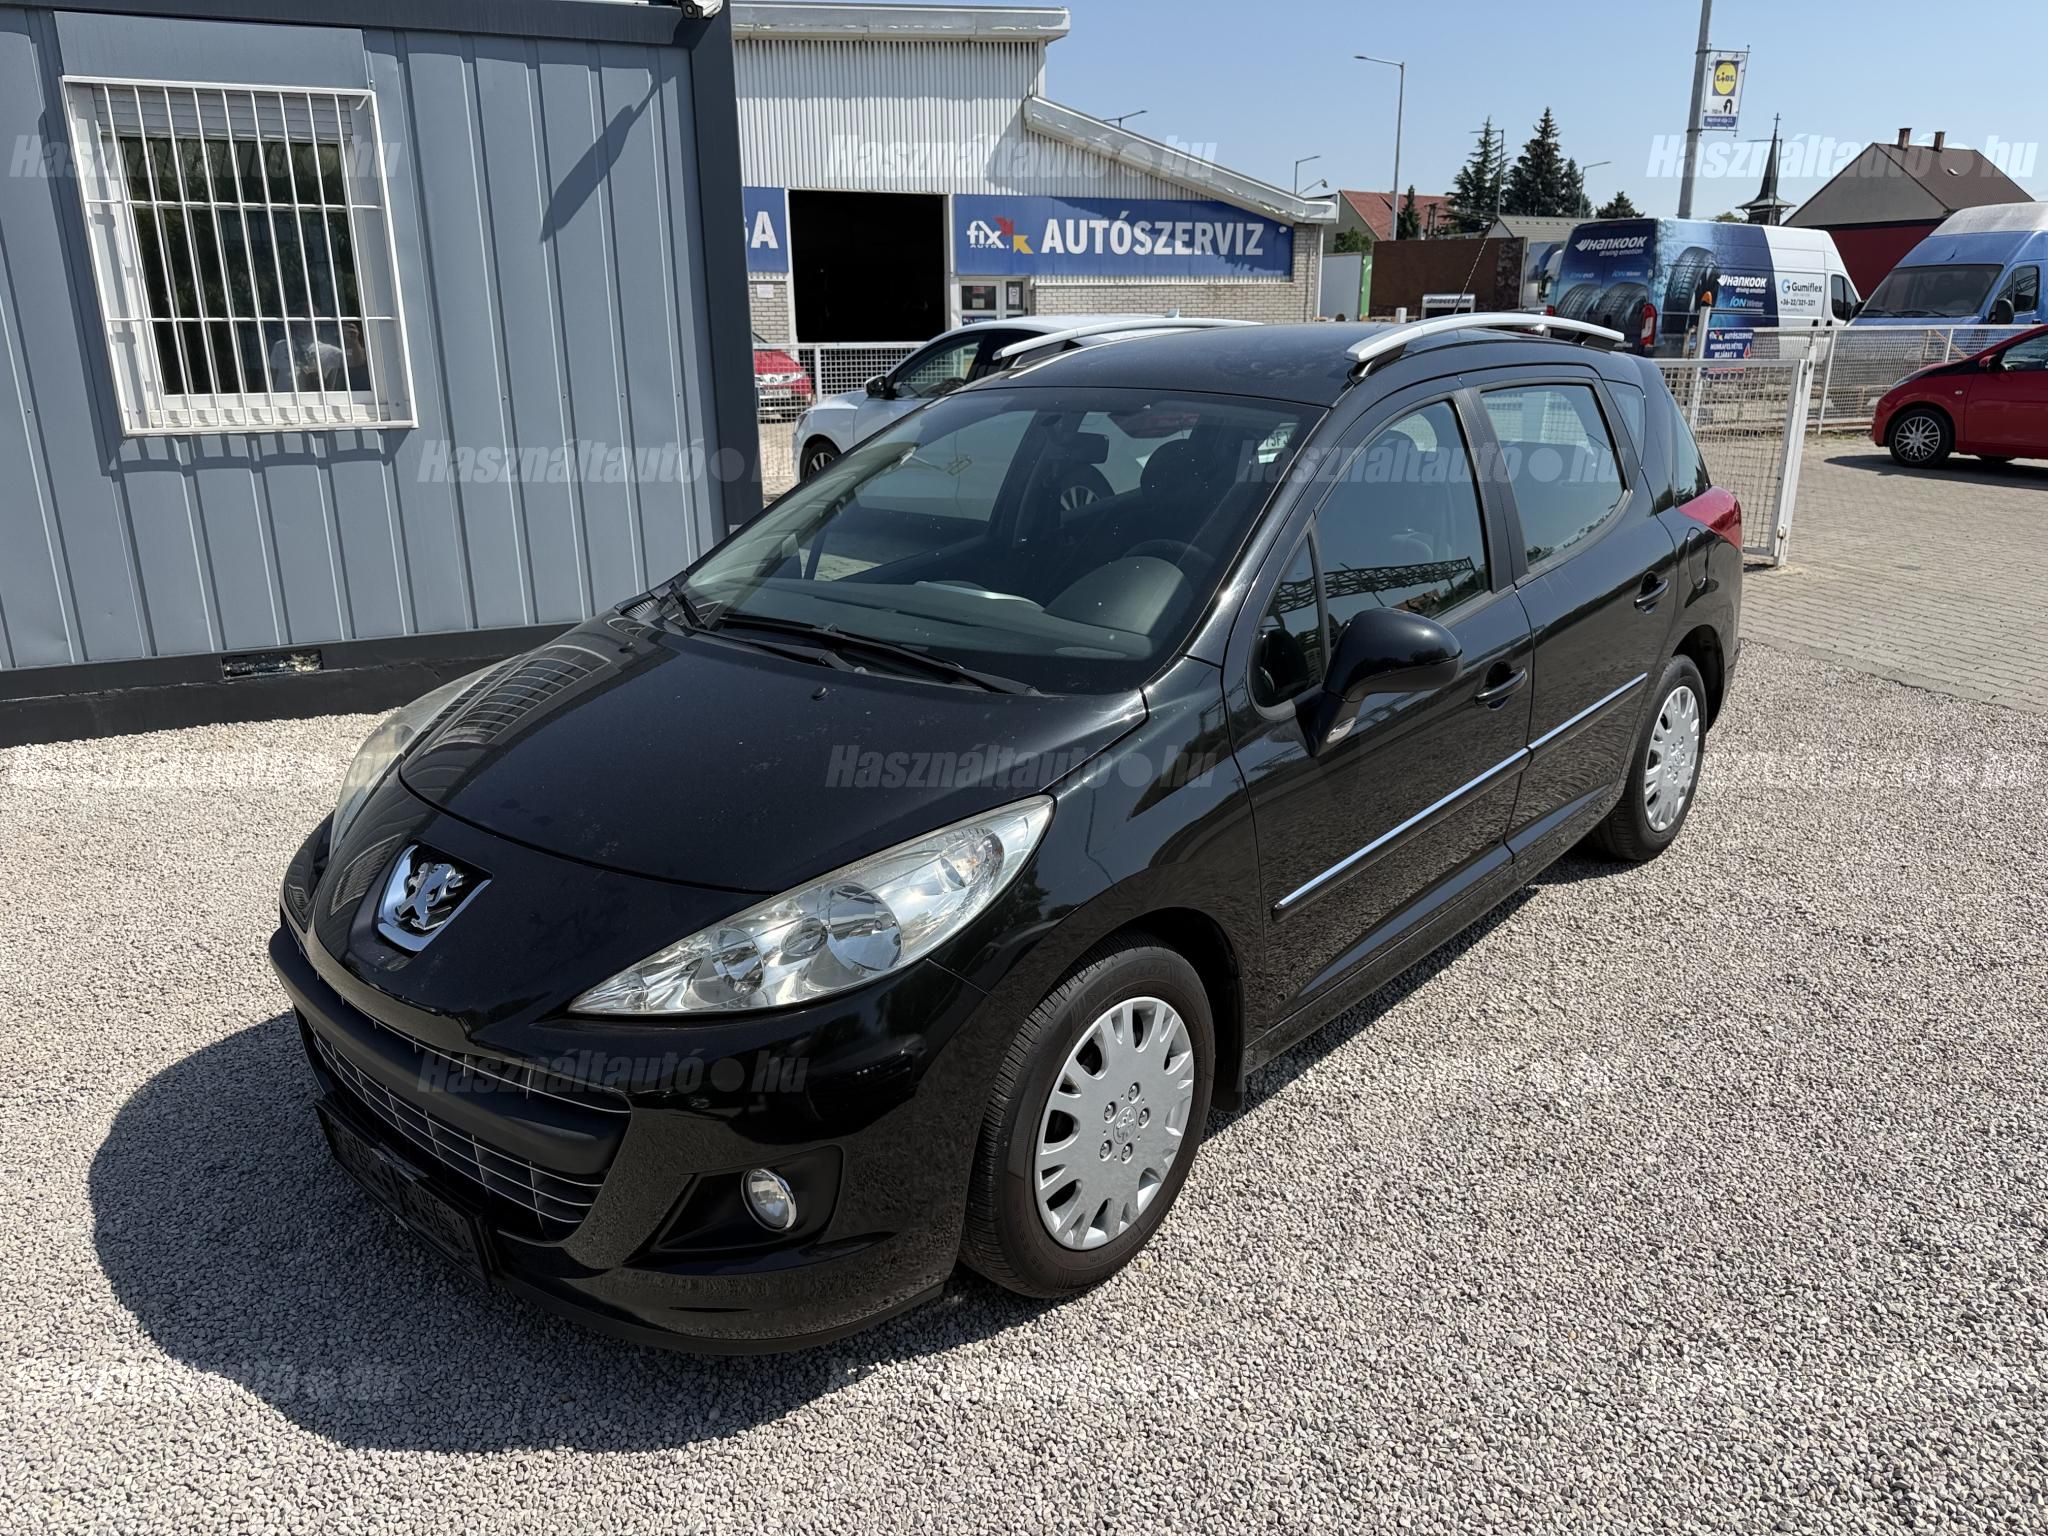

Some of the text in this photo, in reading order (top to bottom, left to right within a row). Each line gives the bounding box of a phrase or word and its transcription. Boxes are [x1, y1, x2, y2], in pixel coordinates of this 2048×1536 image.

[744, 211, 779, 249] A
[966, 211, 1265, 256] fix AUTÓSZERVIZ
[1791, 281, 1823, 293] Gumiflex
